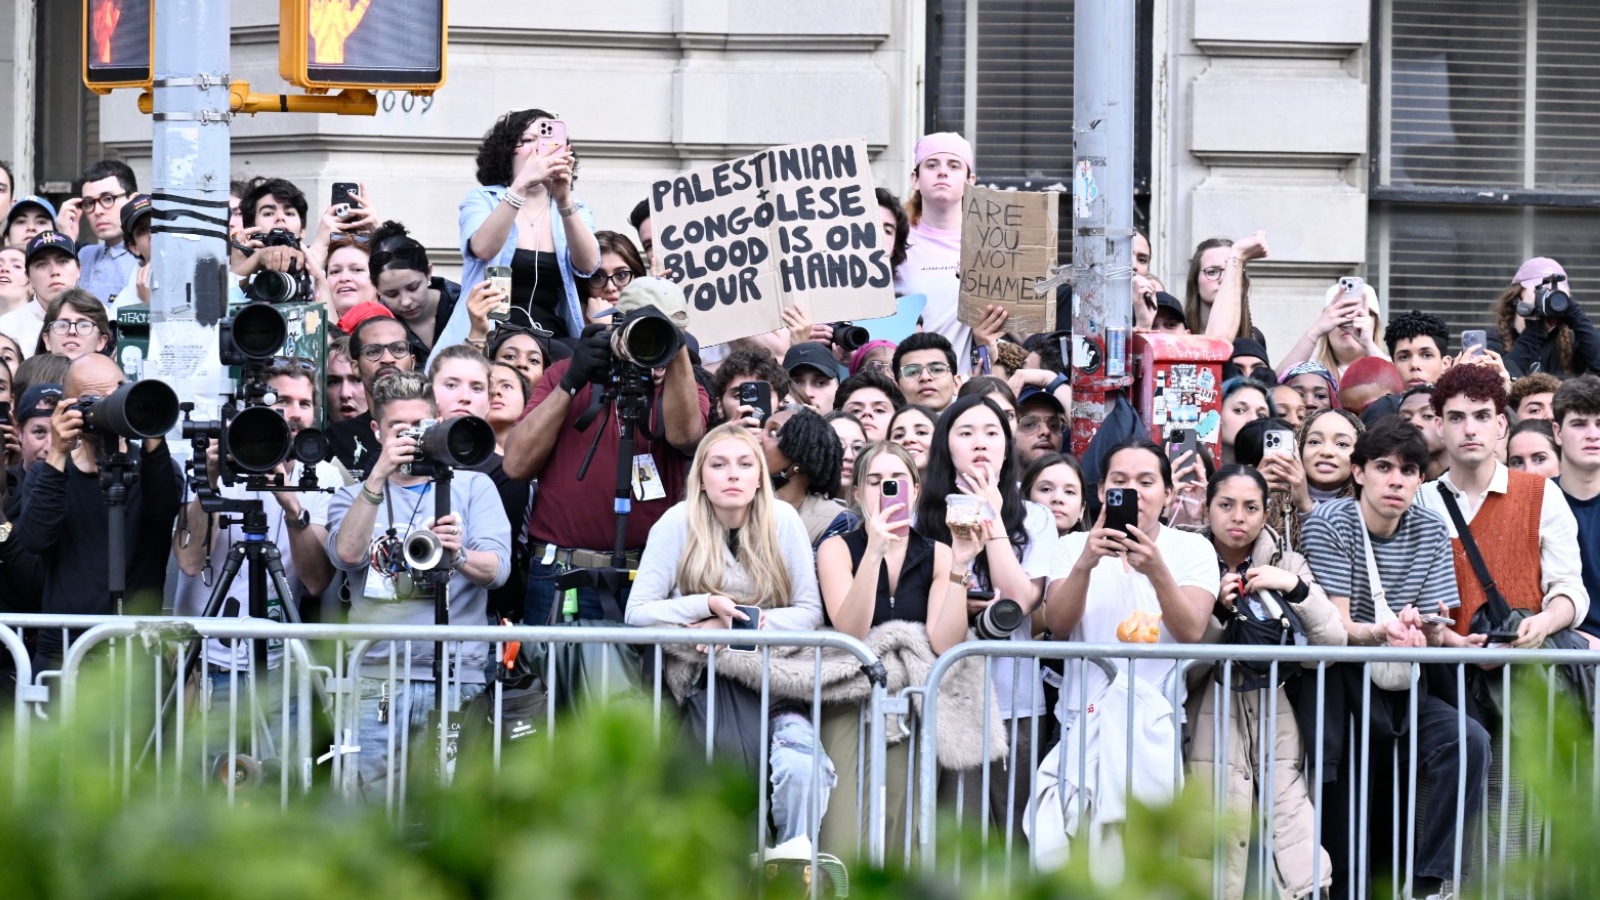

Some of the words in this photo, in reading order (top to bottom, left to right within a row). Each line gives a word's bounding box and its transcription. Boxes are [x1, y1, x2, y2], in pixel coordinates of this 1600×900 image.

[372, 90, 433, 115] 009
[653, 144, 856, 212] PALESTINIAN
[661, 186, 865, 250] CONGOLESE
[966, 196, 1024, 226] ARE
[664, 236, 768, 283] BLOOD
[779, 225, 810, 253] IS
[826, 223, 876, 250] ON
[979, 226, 1019, 249] YOU
[780, 251, 891, 293] HANDS
[973, 250, 1023, 270] NOT
